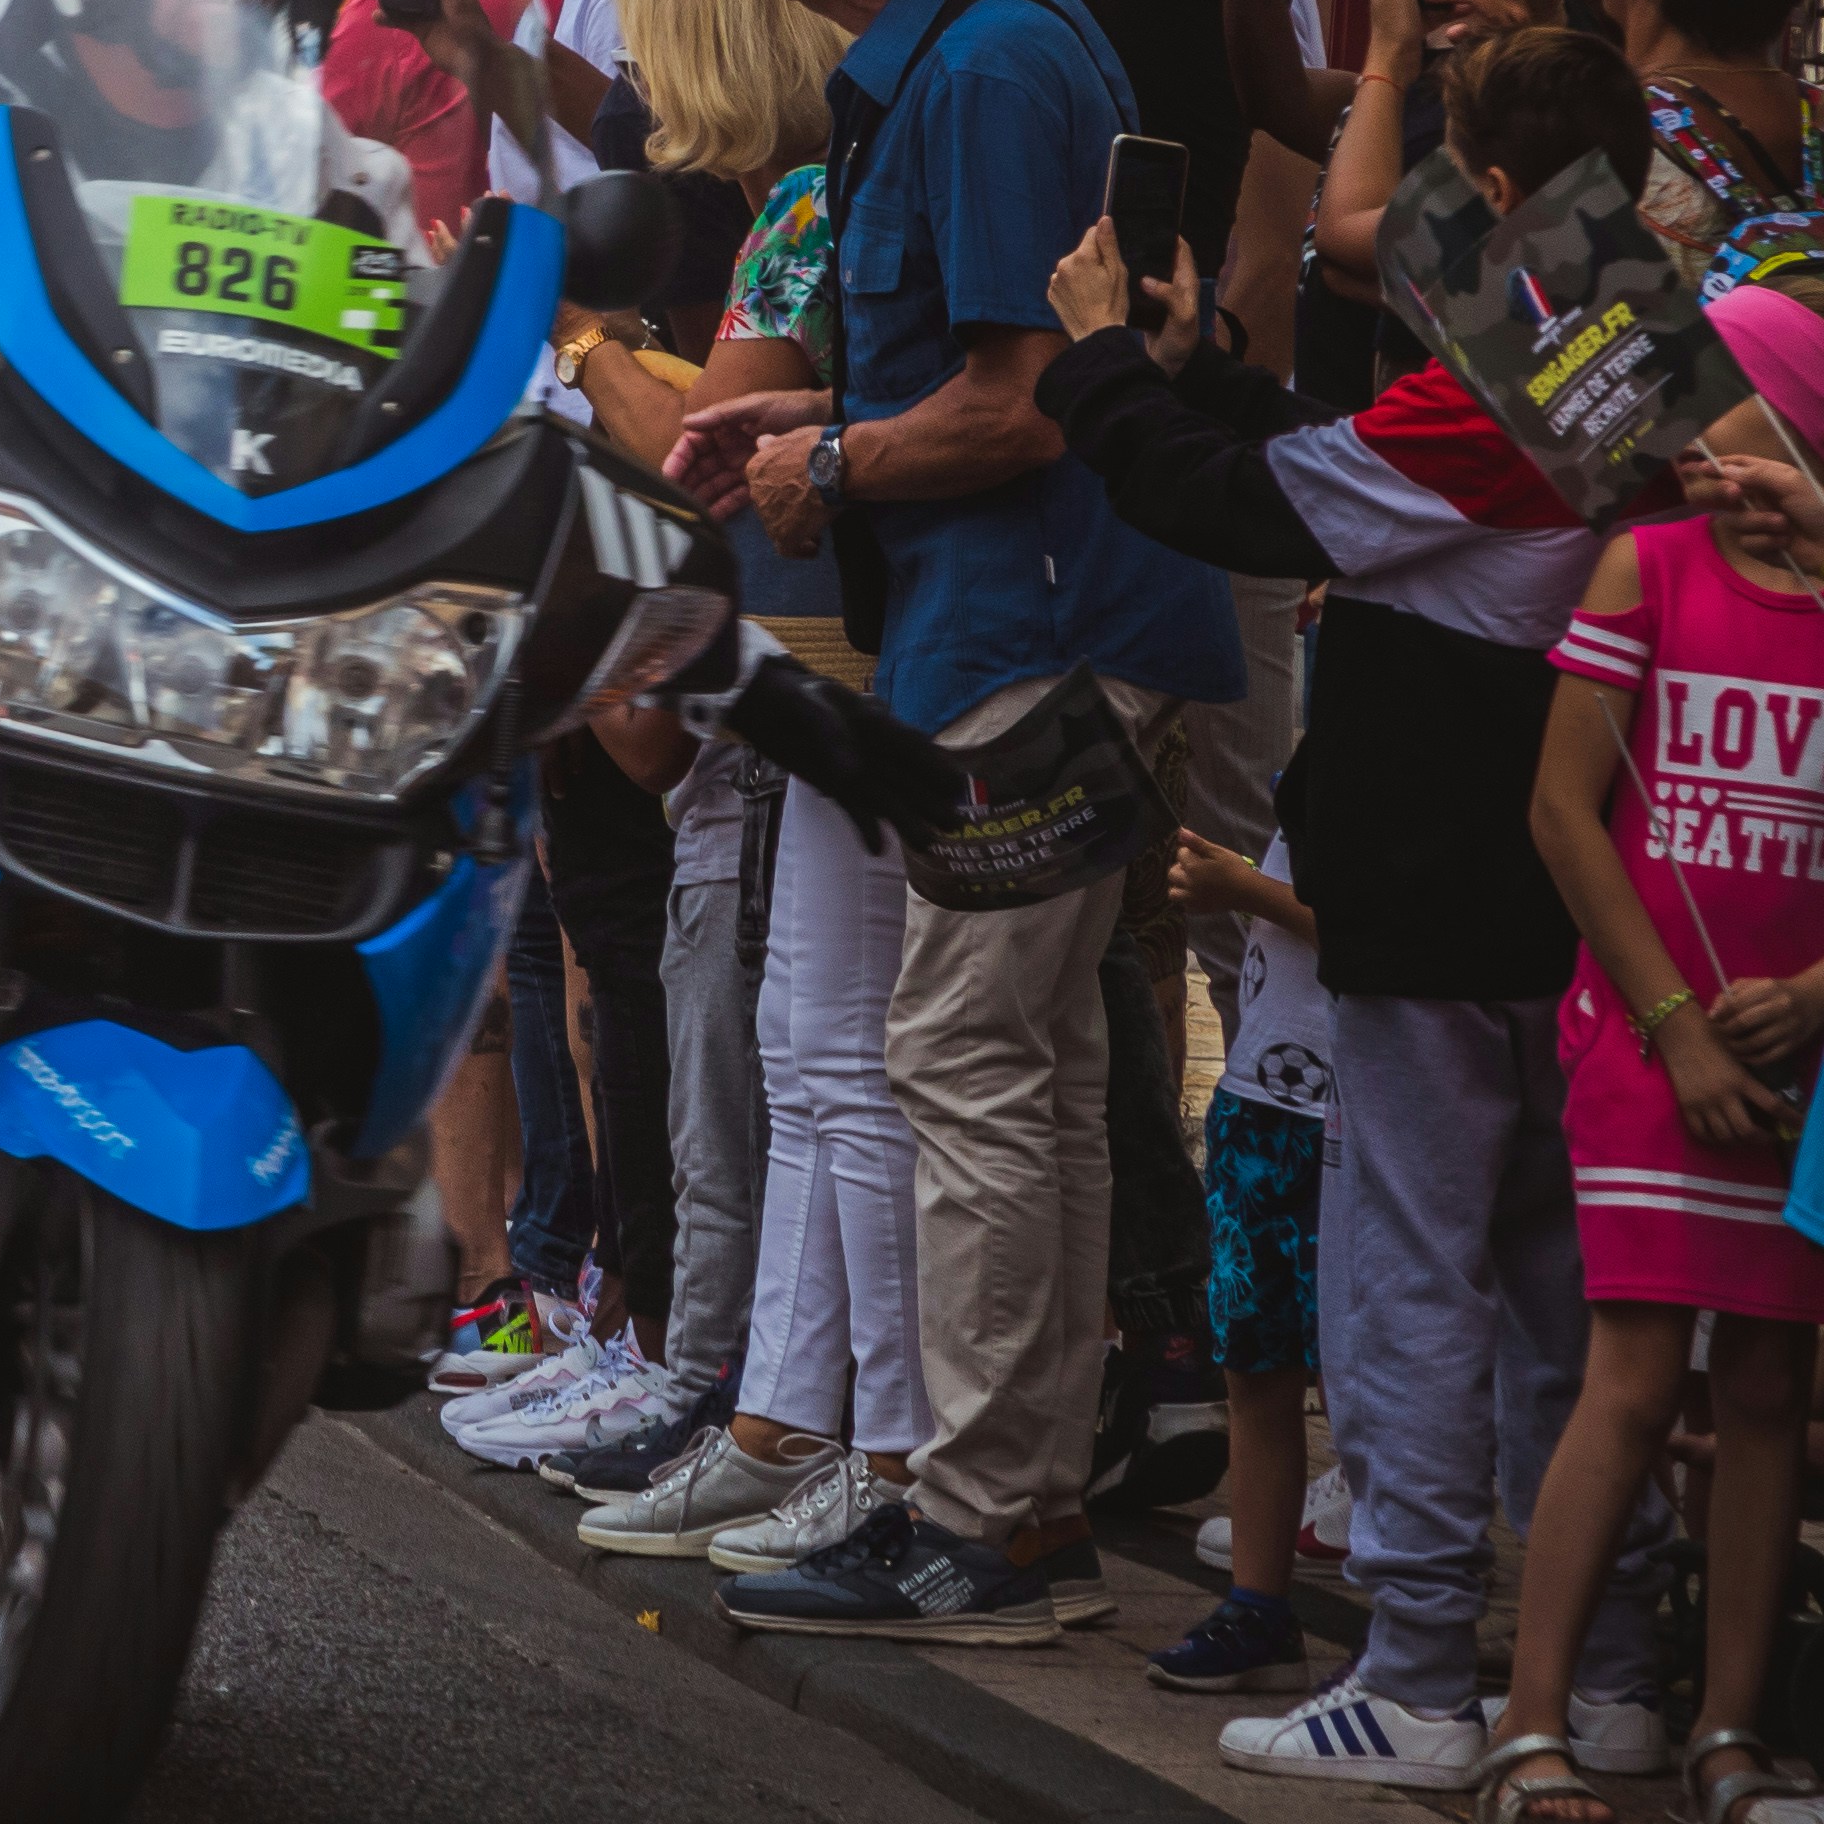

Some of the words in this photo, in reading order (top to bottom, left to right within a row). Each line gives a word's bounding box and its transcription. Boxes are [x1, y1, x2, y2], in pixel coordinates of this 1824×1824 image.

[170, 203, 312, 246] RADIO-TV
[172, 240, 298, 312] 826
[157, 328, 364, 392] EUROMEDIA
[228, 428, 279, 476] K
[1665, 679, 1824, 779] LOV
[949, 784, 1086, 841] AGER.FR
[988, 840, 1022, 857] DE
[1024, 805, 1098, 847] TERRE
[949, 845, 1055, 874] RECRUTE
